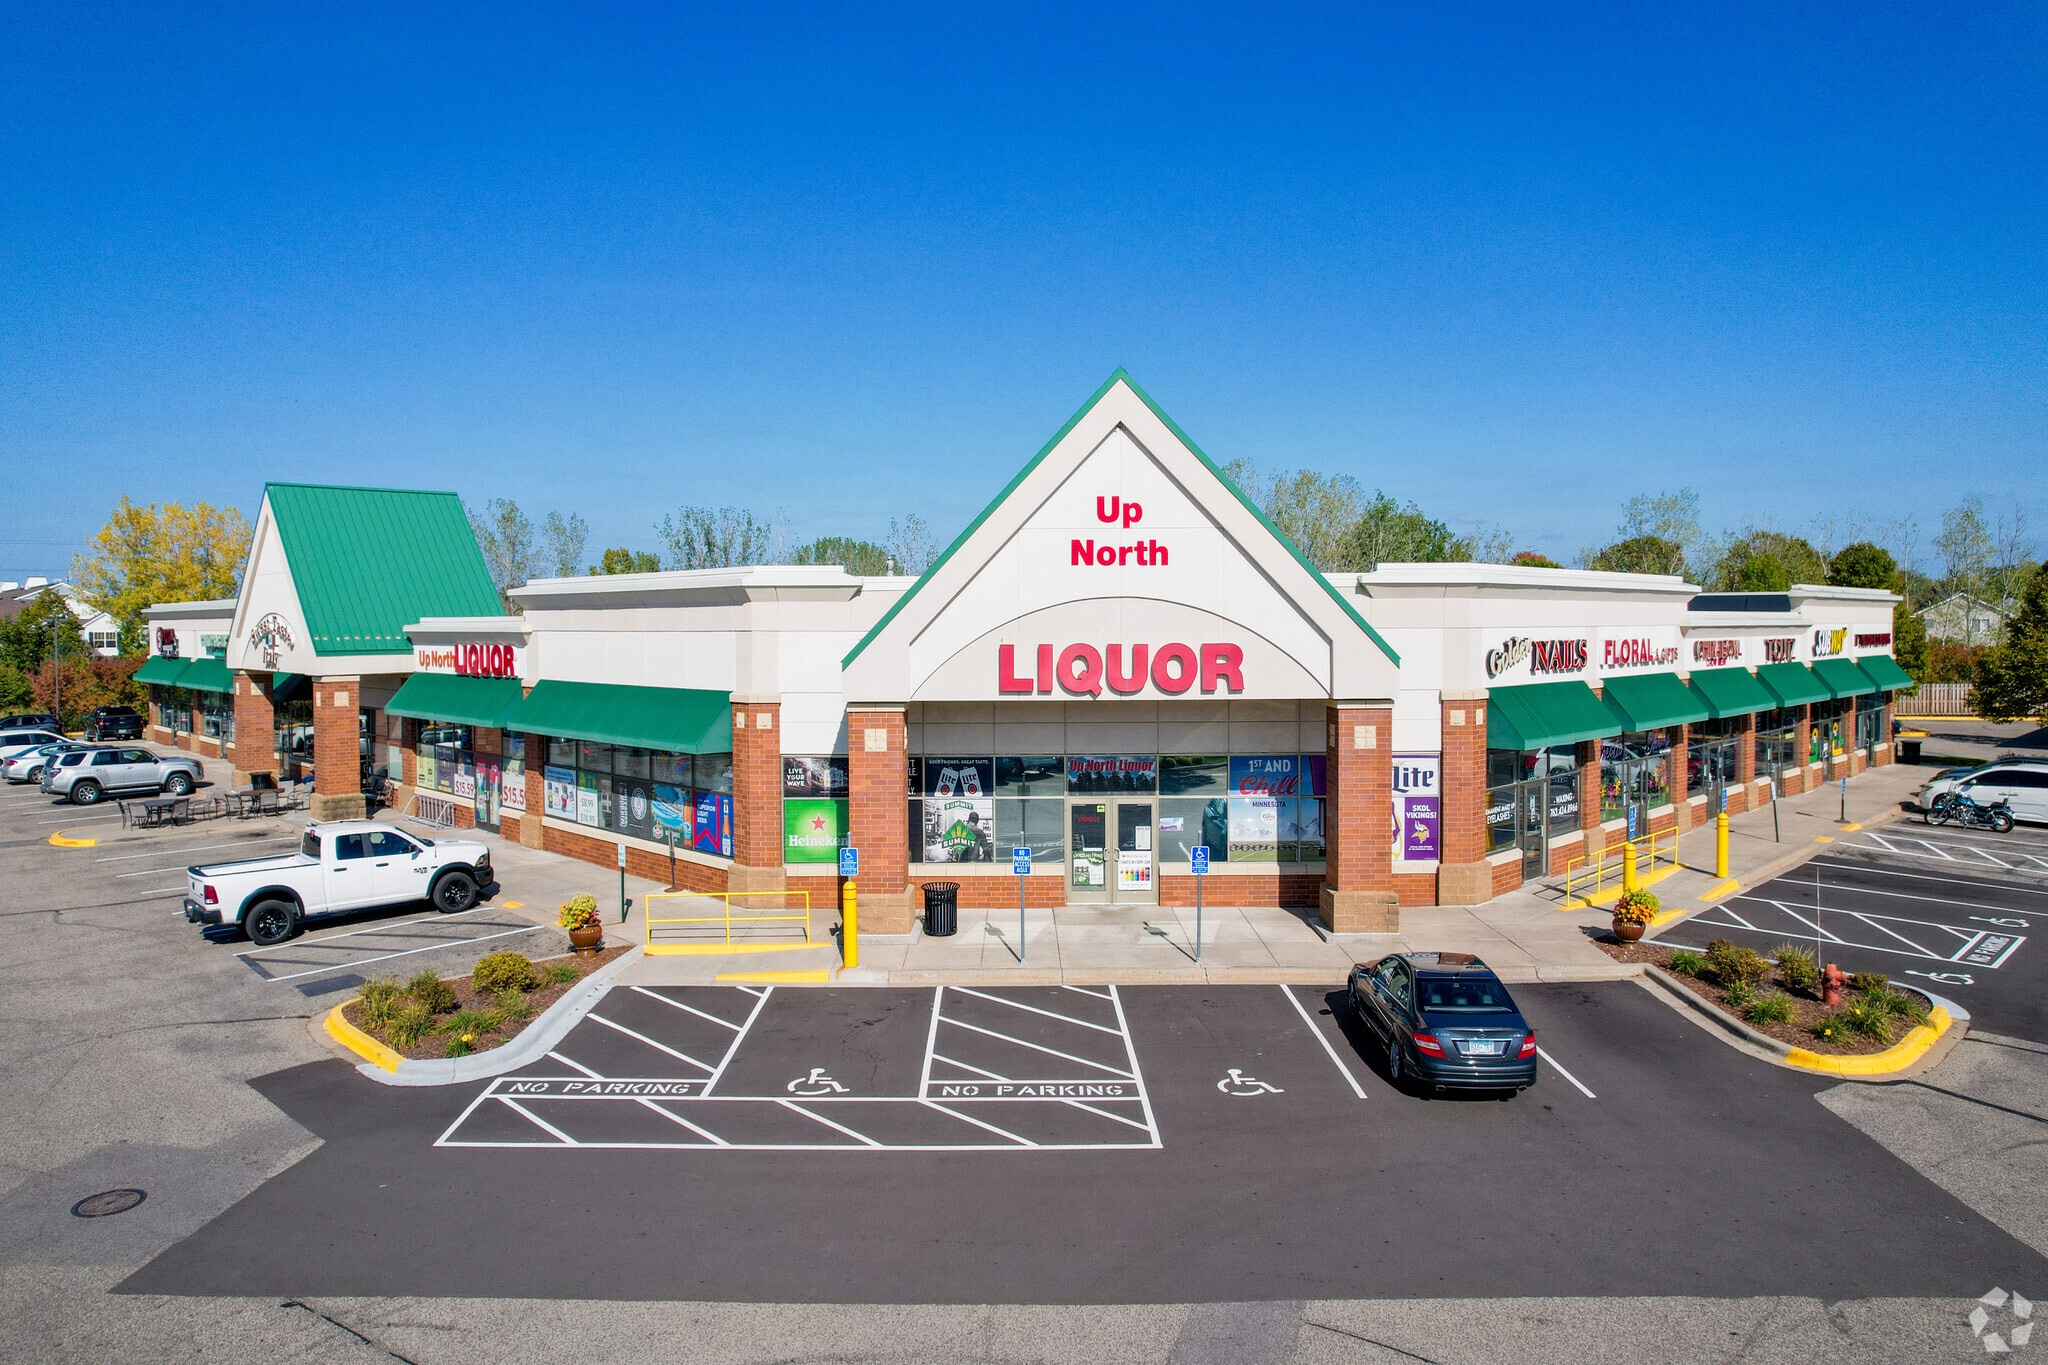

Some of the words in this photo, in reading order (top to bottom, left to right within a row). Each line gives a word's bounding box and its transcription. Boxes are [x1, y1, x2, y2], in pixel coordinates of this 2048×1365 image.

[1096, 496, 1143, 529] Up
[1071, 539, 1169, 566] North
[1814, 629, 1847, 657] SUBWAY
[1488, 637, 1532, 678] Golden
[1534, 639, 1588, 671] NAILS
[1604, 638, 1653, 665] FLORAL
[1660, 647, 1678, 661] GIFTS
[419, 650, 430, 671] Up
[431, 650, 455, 668] North
[454, 644, 515, 678] LIQUOR
[999, 642, 1245, 700] LIQUOR
[1069, 760, 1084, 772] Up
[1085, 760, 1117, 772] North
[1118, 760, 1154, 772] Liquor
[1248, 760, 1262, 773] 1ST
[1264, 759, 1291, 773] AND
[941, 773, 956, 785] Lite
[961, 773, 977, 785] Lite
[1238, 774, 1302, 795] Chill
[1392, 766, 1434, 794] Lite
[455, 780, 474, 797] $15.59
[581, 797, 594, 809] $8.99
[1555, 792, 1573, 804] WAXING
[697, 803, 716, 813] SUPERIOR
[1406, 811, 1437, 819] VIKINGS!
[1412, 804, 1431, 812] SKOL
[788, 834, 850, 848] Heineken
[943, 839, 976, 848] SUMMIT
[503, 1082, 549, 1093] NO
[562, 1083, 690, 1094] PARKING
[942, 1085, 979, 1096] NO
[997, 1085, 1123, 1096] PARKING
